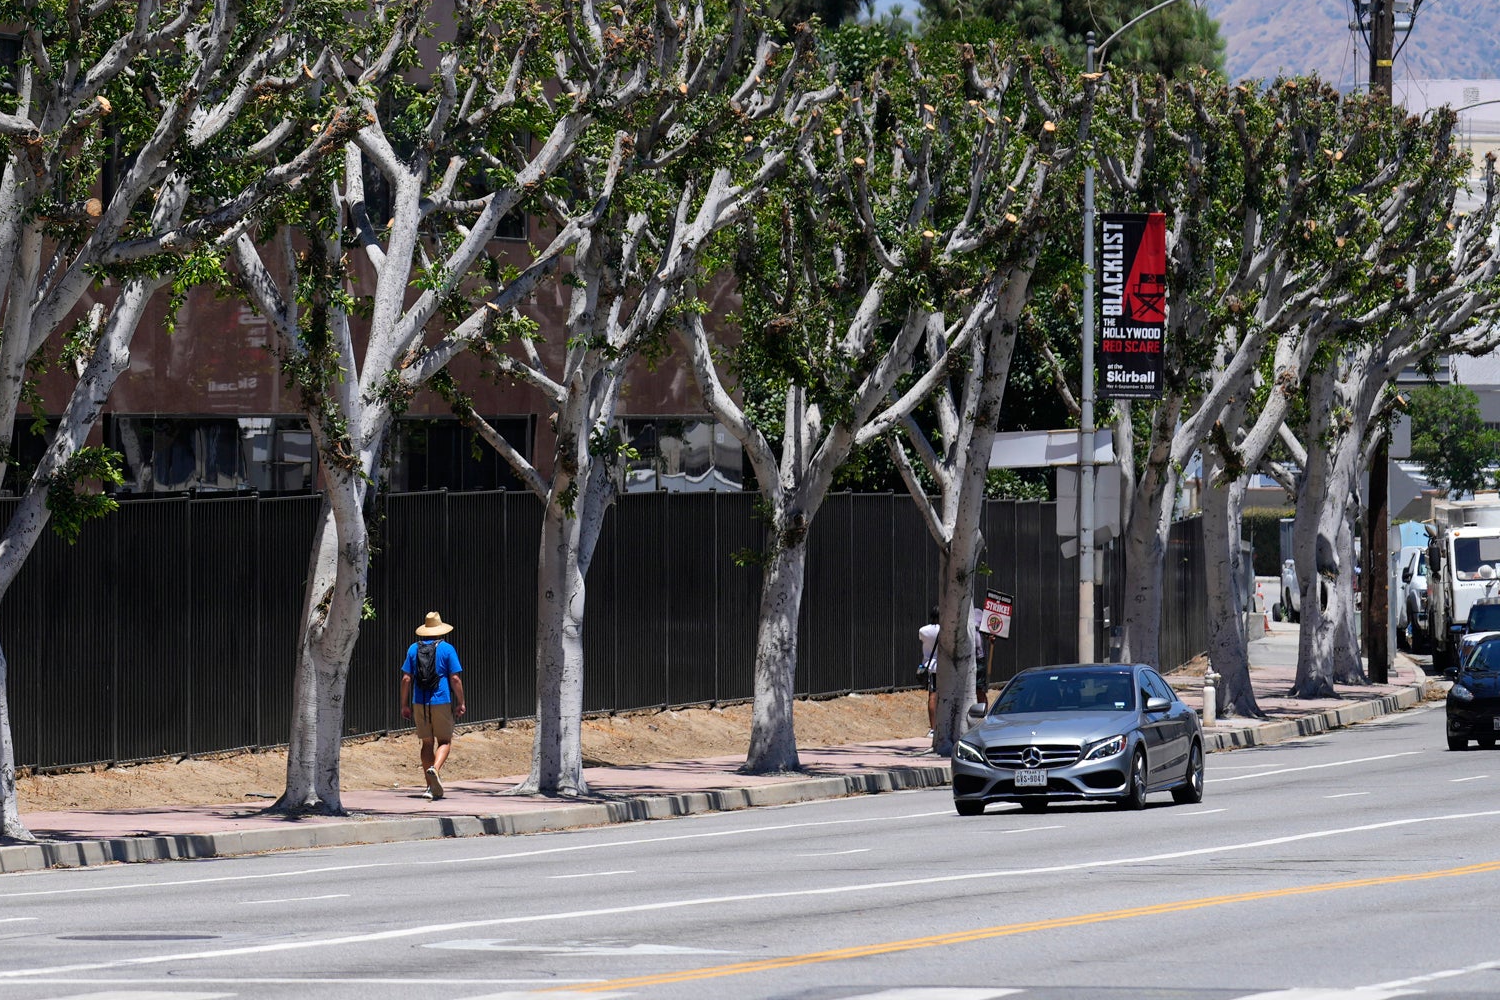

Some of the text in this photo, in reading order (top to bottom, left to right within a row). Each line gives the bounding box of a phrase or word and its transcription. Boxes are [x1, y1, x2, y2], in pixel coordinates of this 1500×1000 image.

[1102, 221, 1124, 316] BLACKLIST
[1103, 318, 1116, 327] THE
[1102, 327, 1161, 339] HOLLYWOOD
[1103, 340, 1160, 353] RED SCARE
[1106, 370, 1155, 383] Skirball
[985, 600, 1011, 616] STRIKE!
